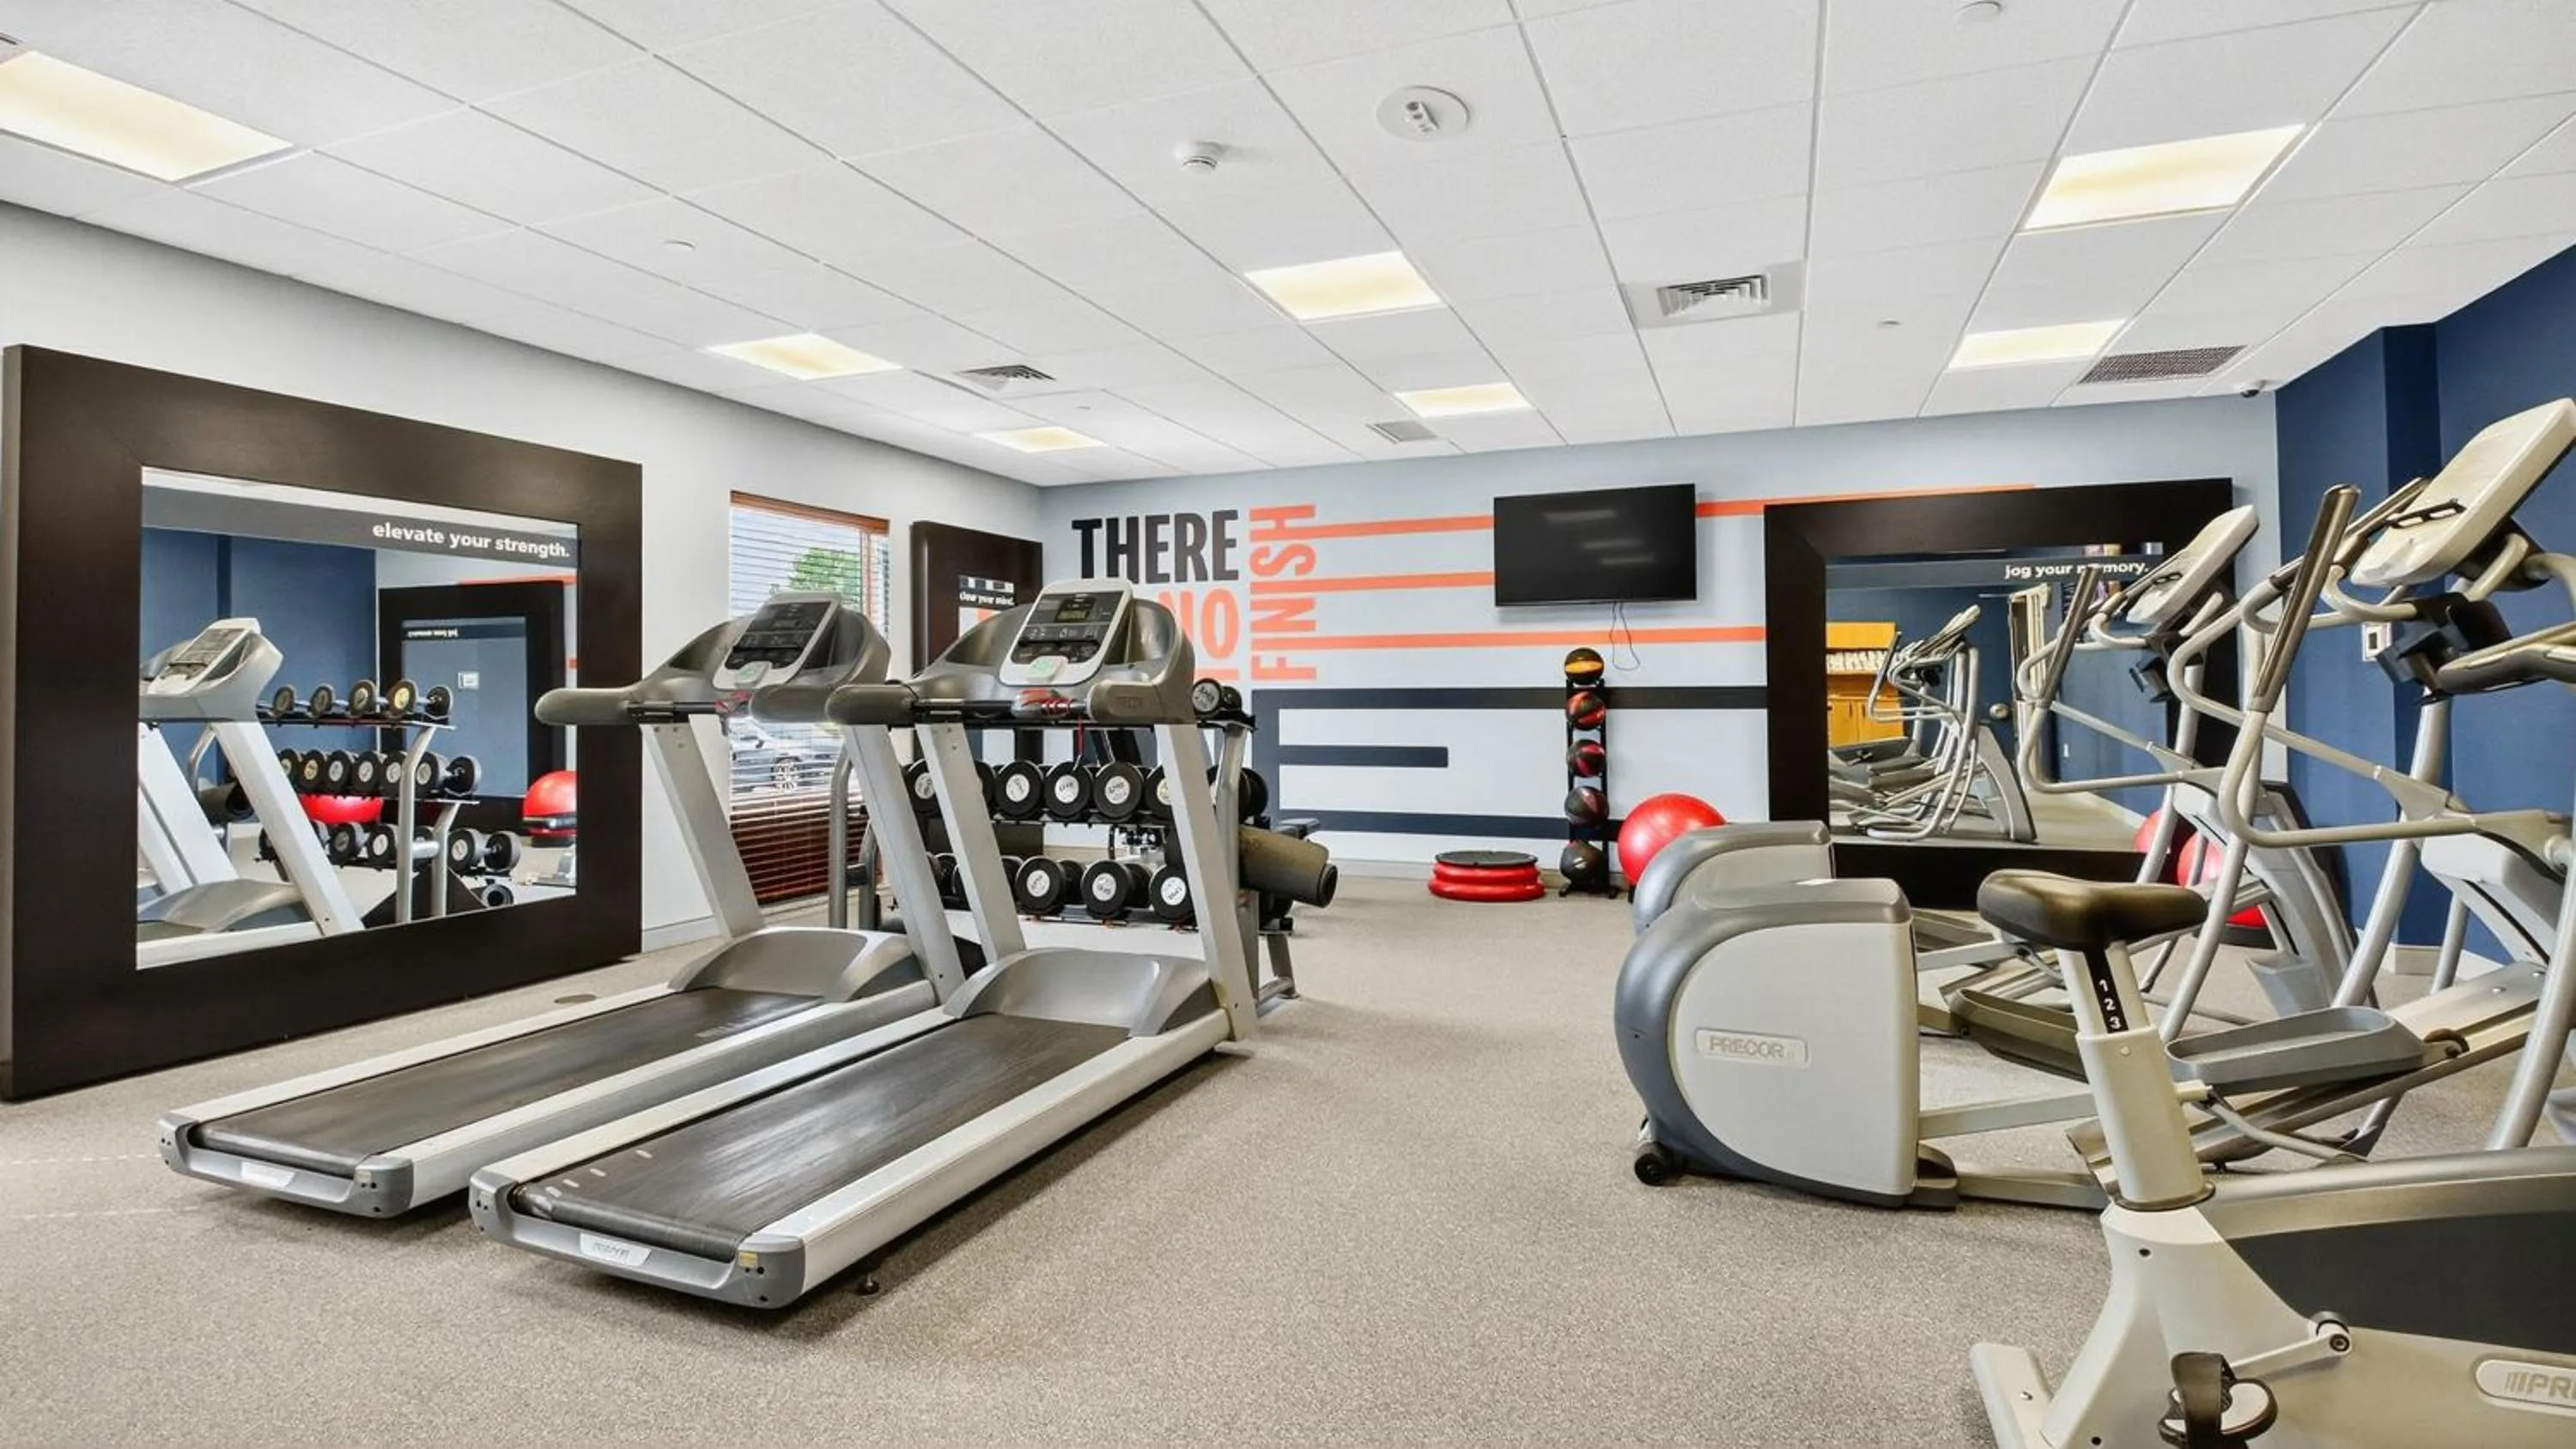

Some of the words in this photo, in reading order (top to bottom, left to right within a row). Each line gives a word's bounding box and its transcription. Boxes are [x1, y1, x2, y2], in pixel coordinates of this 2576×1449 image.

[372, 522, 445, 543] elevate
[449, 533, 491, 549] your
[495, 537, 570, 558] strength.
[1072, 509, 1239, 585] THERE
[2005, 564, 2032, 579] jog
[2034, 564, 2073, 579] your
[2076, 562, 2149, 576] mmory.
[1249, 504, 1317, 681] FINISH
[2099, 979, 2109, 992] 1
[2104, 997, 2117, 1011] 2
[2109, 1016, 2122, 1029] 3
[1709, 1035, 1786, 1058] PRECOR
[2524, 1372, 2576, 1400] PR
